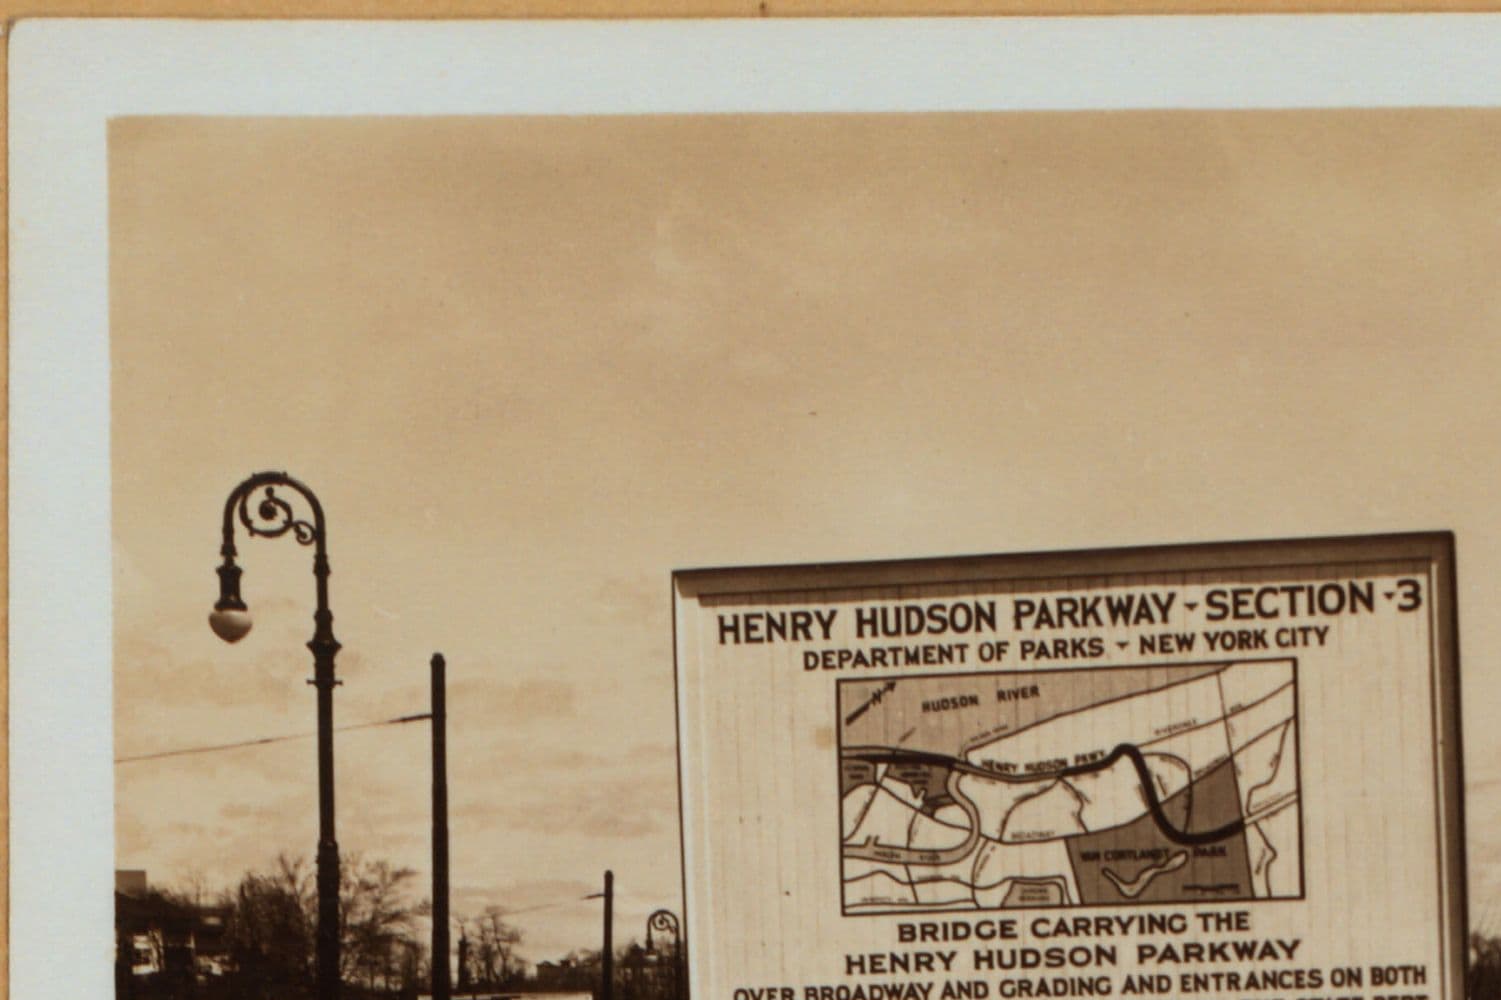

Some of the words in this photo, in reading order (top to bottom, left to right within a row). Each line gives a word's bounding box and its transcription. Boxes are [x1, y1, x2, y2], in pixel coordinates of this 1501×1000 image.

[718, 609, 837, 645] HENRY
[856, 601, 996, 639] HUDSON
[1014, 591, 1176, 631] PARKWAY
[1205, 581, 1374, 620] SECTION
[803, 643, 969, 671] DEPARTMENT
[978, 641, 1010, 663] OF
[1020, 636, 1105, 661] PARKS
[1139, 632, 1196, 655] NEW
[1203, 629, 1267, 652] YORK
[1275, 626, 1330, 648] CITY
[922, 695, 979, 713] HUDSON
[997, 685, 1040, 701] RIVER
[981, 759, 1018, 773] HENRY
[1024, 758, 1068, 772] HUDSON
[1074, 750, 1106, 764] PKWY
[897, 919, 1018, 943] BRIDGE
[1031, 913, 1187, 939] CARRYING
[1197, 911, 1250, 932] THE
[845, 951, 956, 975] HENRY
[974, 945, 1117, 971] HUDSON
[1137, 939, 1301, 965] PARKWAY
[940, 980, 989, 1000] AND
[1000, 976, 1111, 998] GRADING
[1121, 974, 1171, 995] AND
[1180, 969, 1323, 993] ENTRANCES
[1331, 968, 1362, 988] ON
[1370, 966, 1426, 986] BOTH
